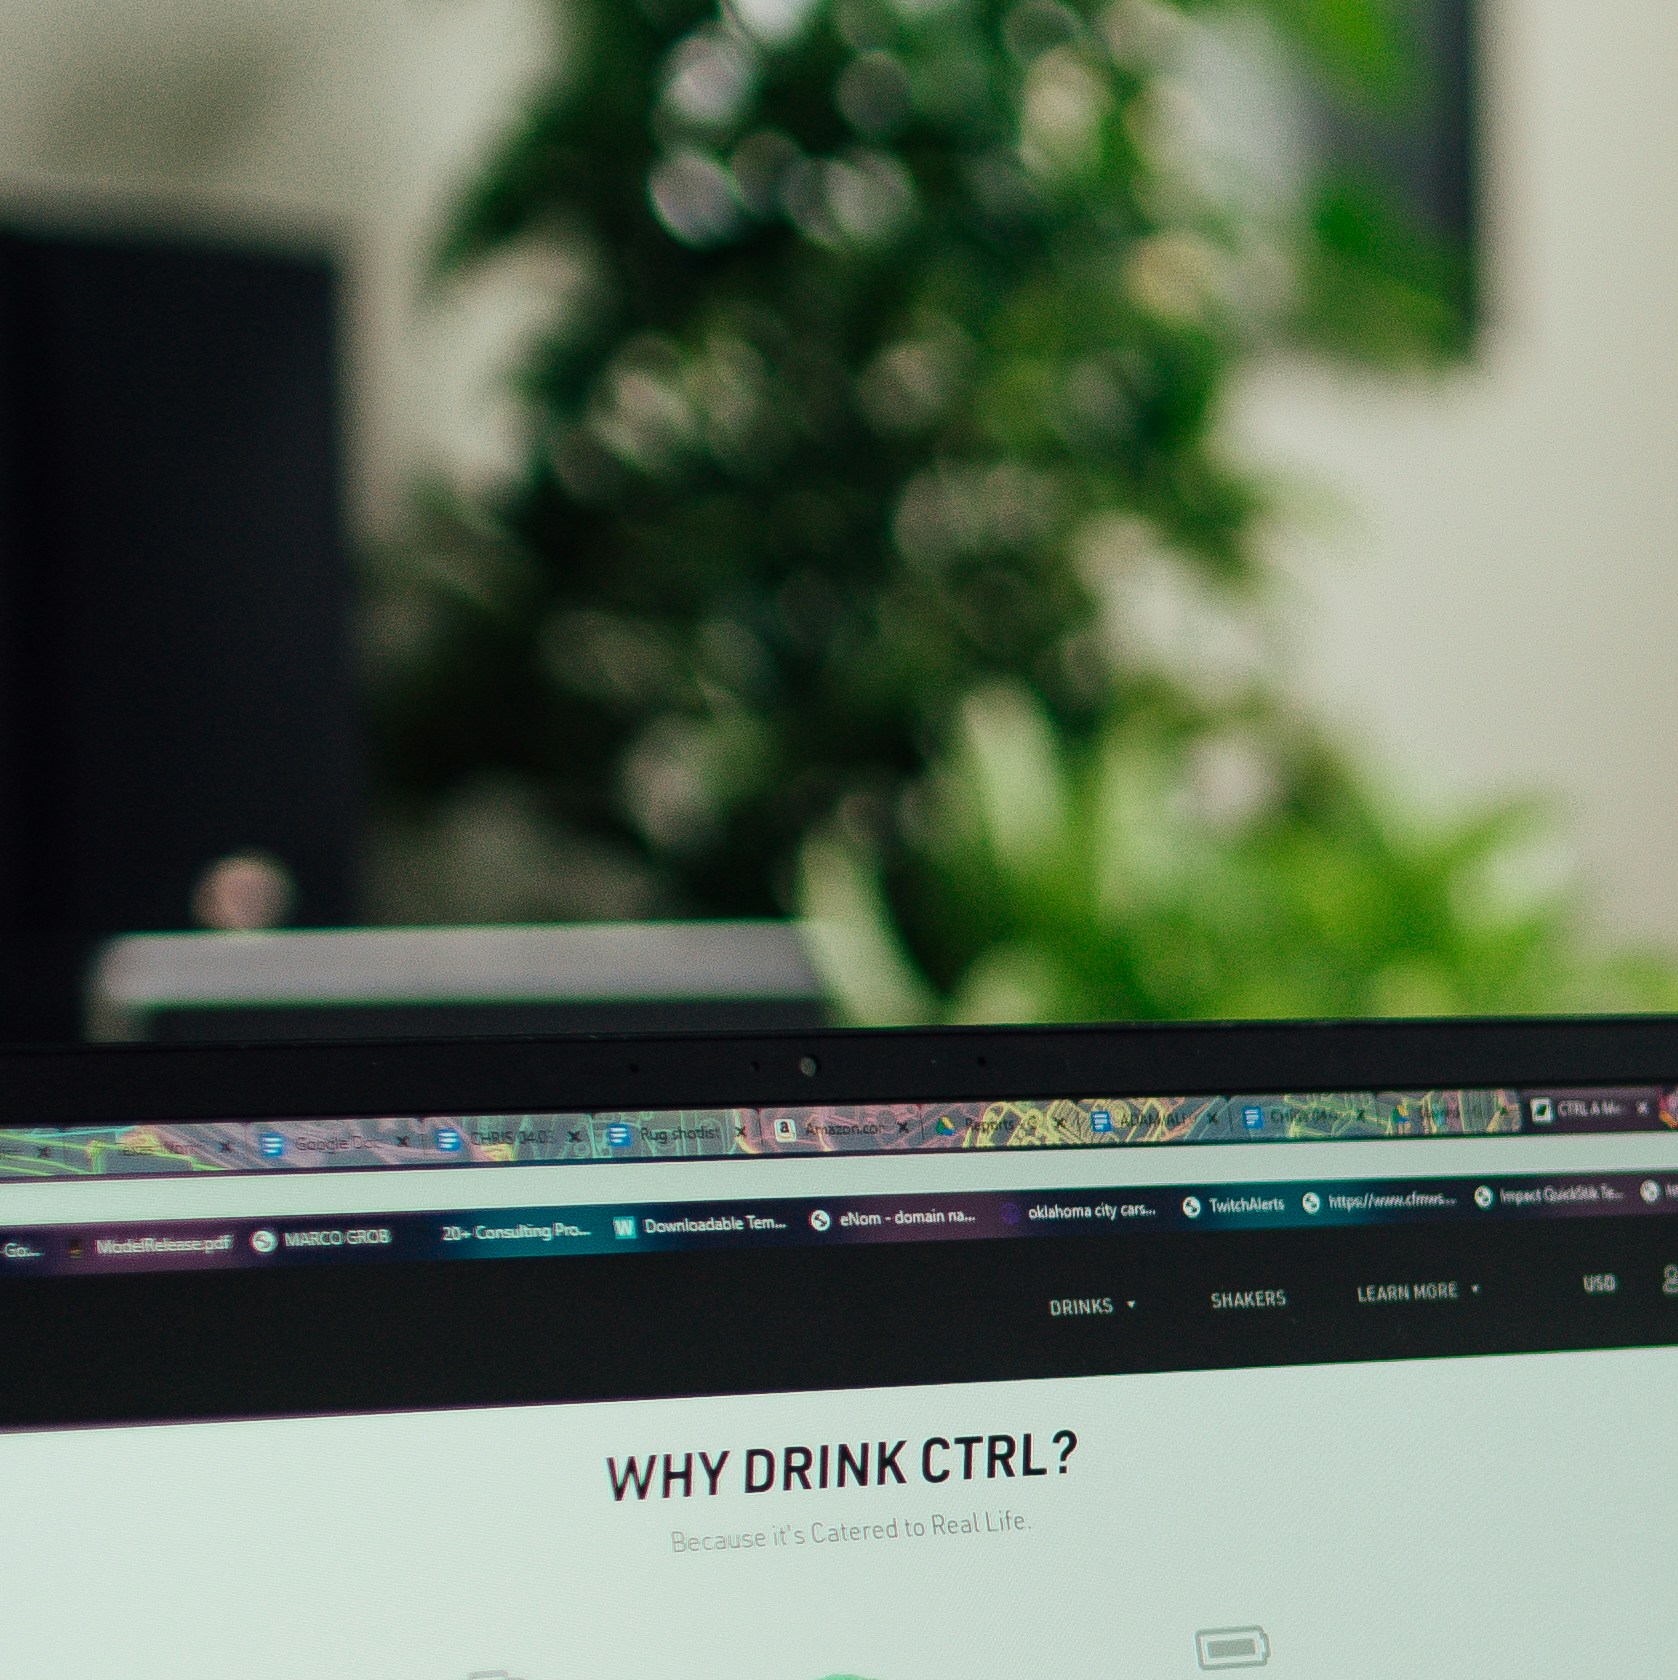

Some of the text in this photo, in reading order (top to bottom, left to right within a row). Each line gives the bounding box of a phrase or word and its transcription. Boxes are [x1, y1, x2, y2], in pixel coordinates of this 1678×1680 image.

[1028, 1203, 1092, 1220] oklahoma
[1094, 1202, 1119, 1222] city
[1209, 1196, 1286, 1214] TwitchAlerts
[644, 1217, 744, 1235] Downloadable
[840, 1210, 882, 1228] eNom
[894, 1208, 946, 1226] domain
[284, 1229, 393, 1248] MARCO GROB
[475, 1222, 553, 1243] Consulting
[1210, 1288, 1287, 1311] SHAKERS
[1357, 1280, 1459, 1303] LEARN MORE
[1050, 1297, 1115, 1319] DRINKS
[605, 1429, 1079, 1502] WHY DRINK CTRL?
[670, 1510, 1034, 1554] Because it's Catered to Real Life.
